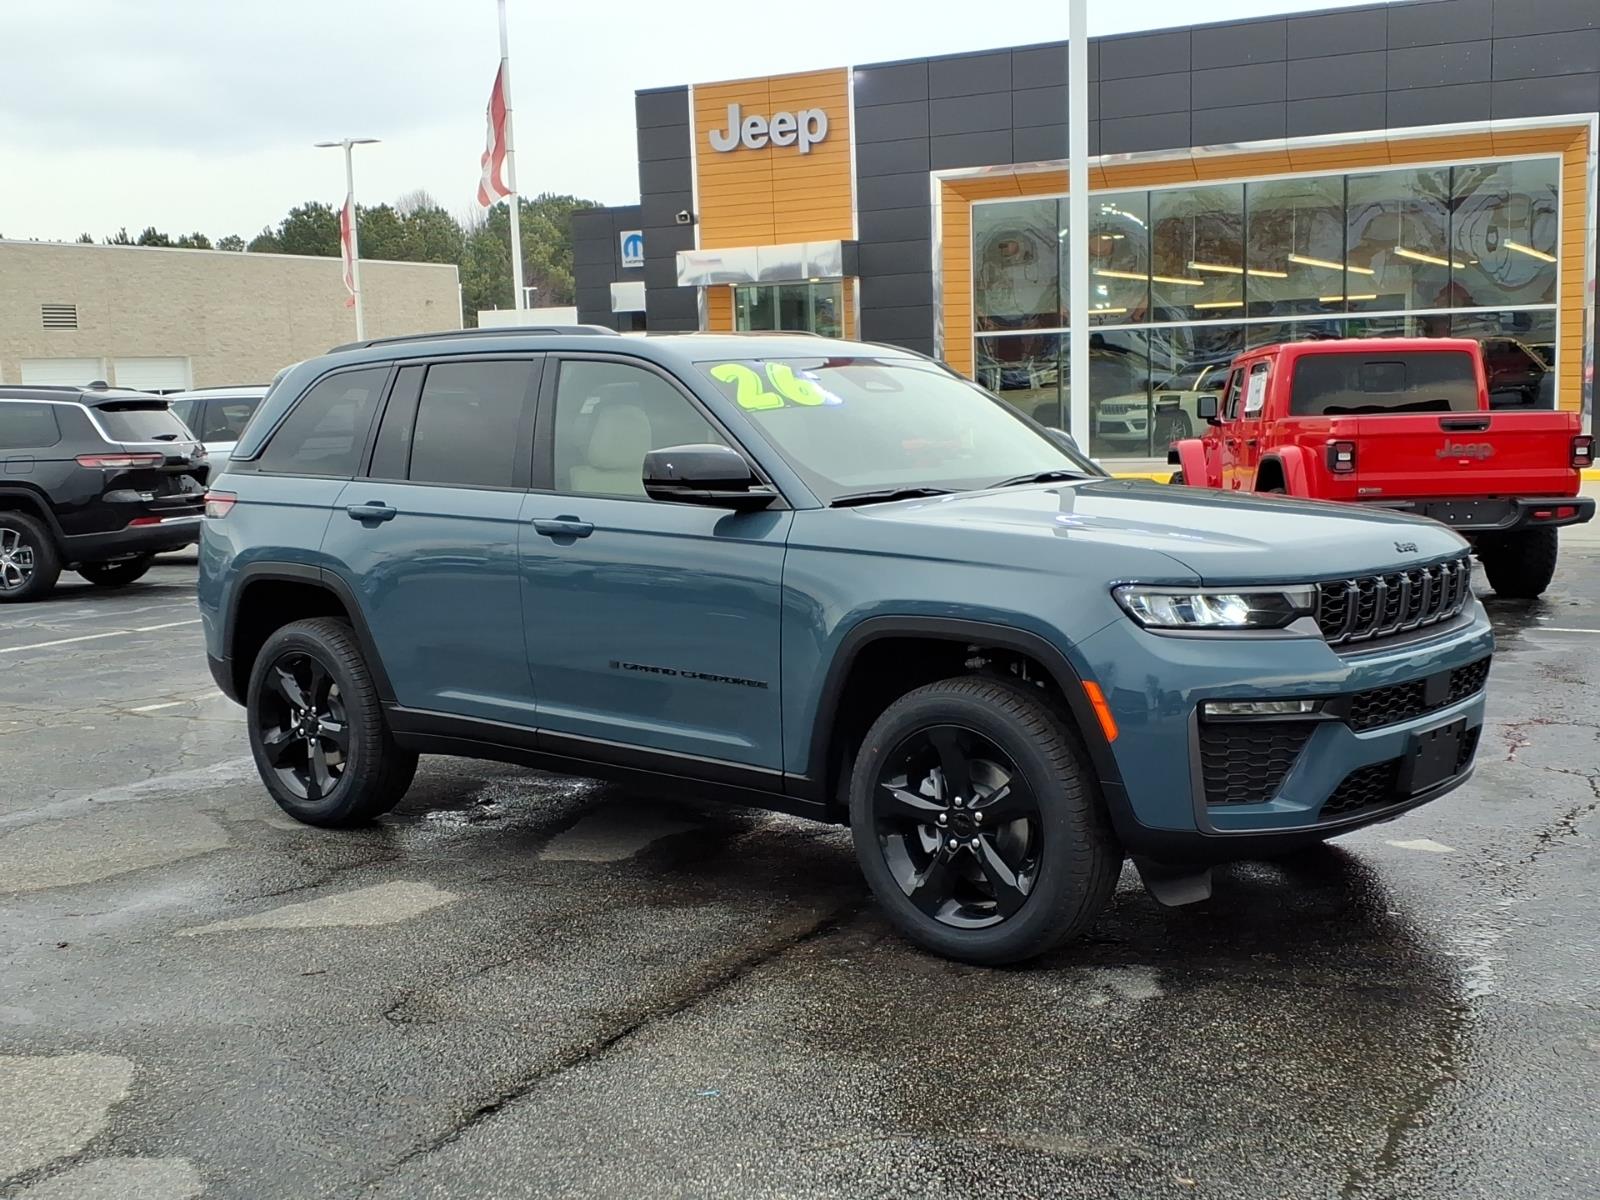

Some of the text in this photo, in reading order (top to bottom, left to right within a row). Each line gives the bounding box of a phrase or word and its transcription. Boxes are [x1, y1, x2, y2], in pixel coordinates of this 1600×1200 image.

[708, 103, 828, 153] Jeep
[710, 363, 826, 411] 26
[1435, 438, 1494, 460] Jeep
[1393, 541, 1418, 553] Jeep
[622, 663, 769, 689] GRAND CHEROKEE
